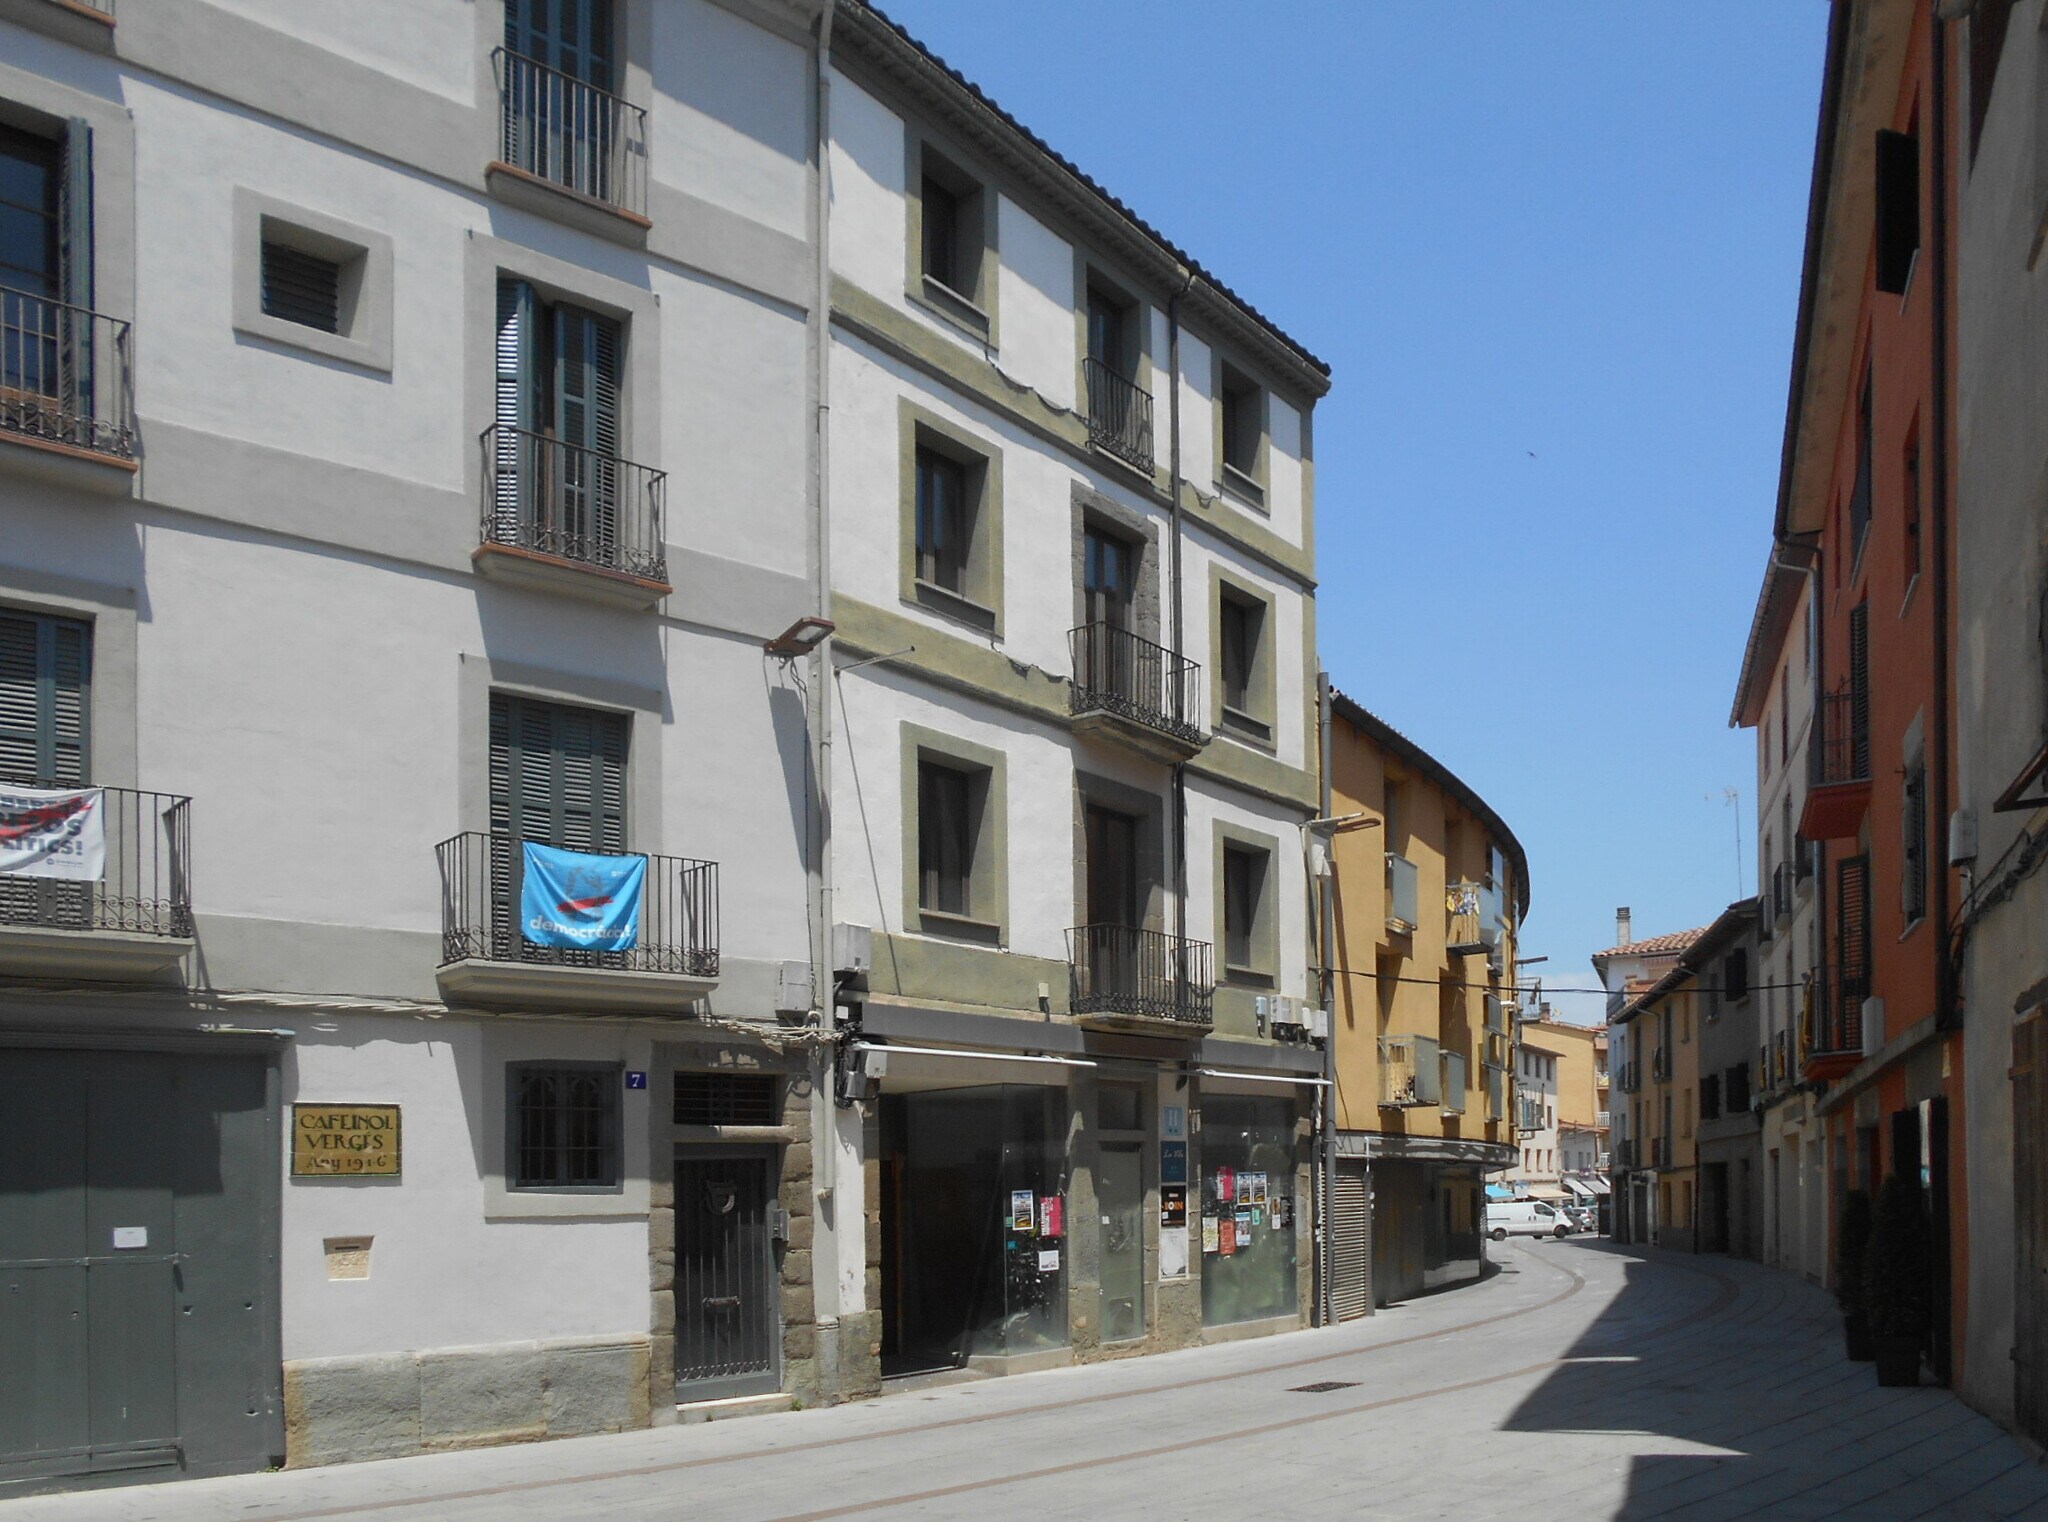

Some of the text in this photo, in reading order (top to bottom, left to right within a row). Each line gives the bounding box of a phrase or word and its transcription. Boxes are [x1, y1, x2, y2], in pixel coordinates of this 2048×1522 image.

[631, 1074, 641, 1088] 7
[300, 1114, 393, 1129] CAFEINOL
[305, 1132, 383, 1150] VERGÉS
